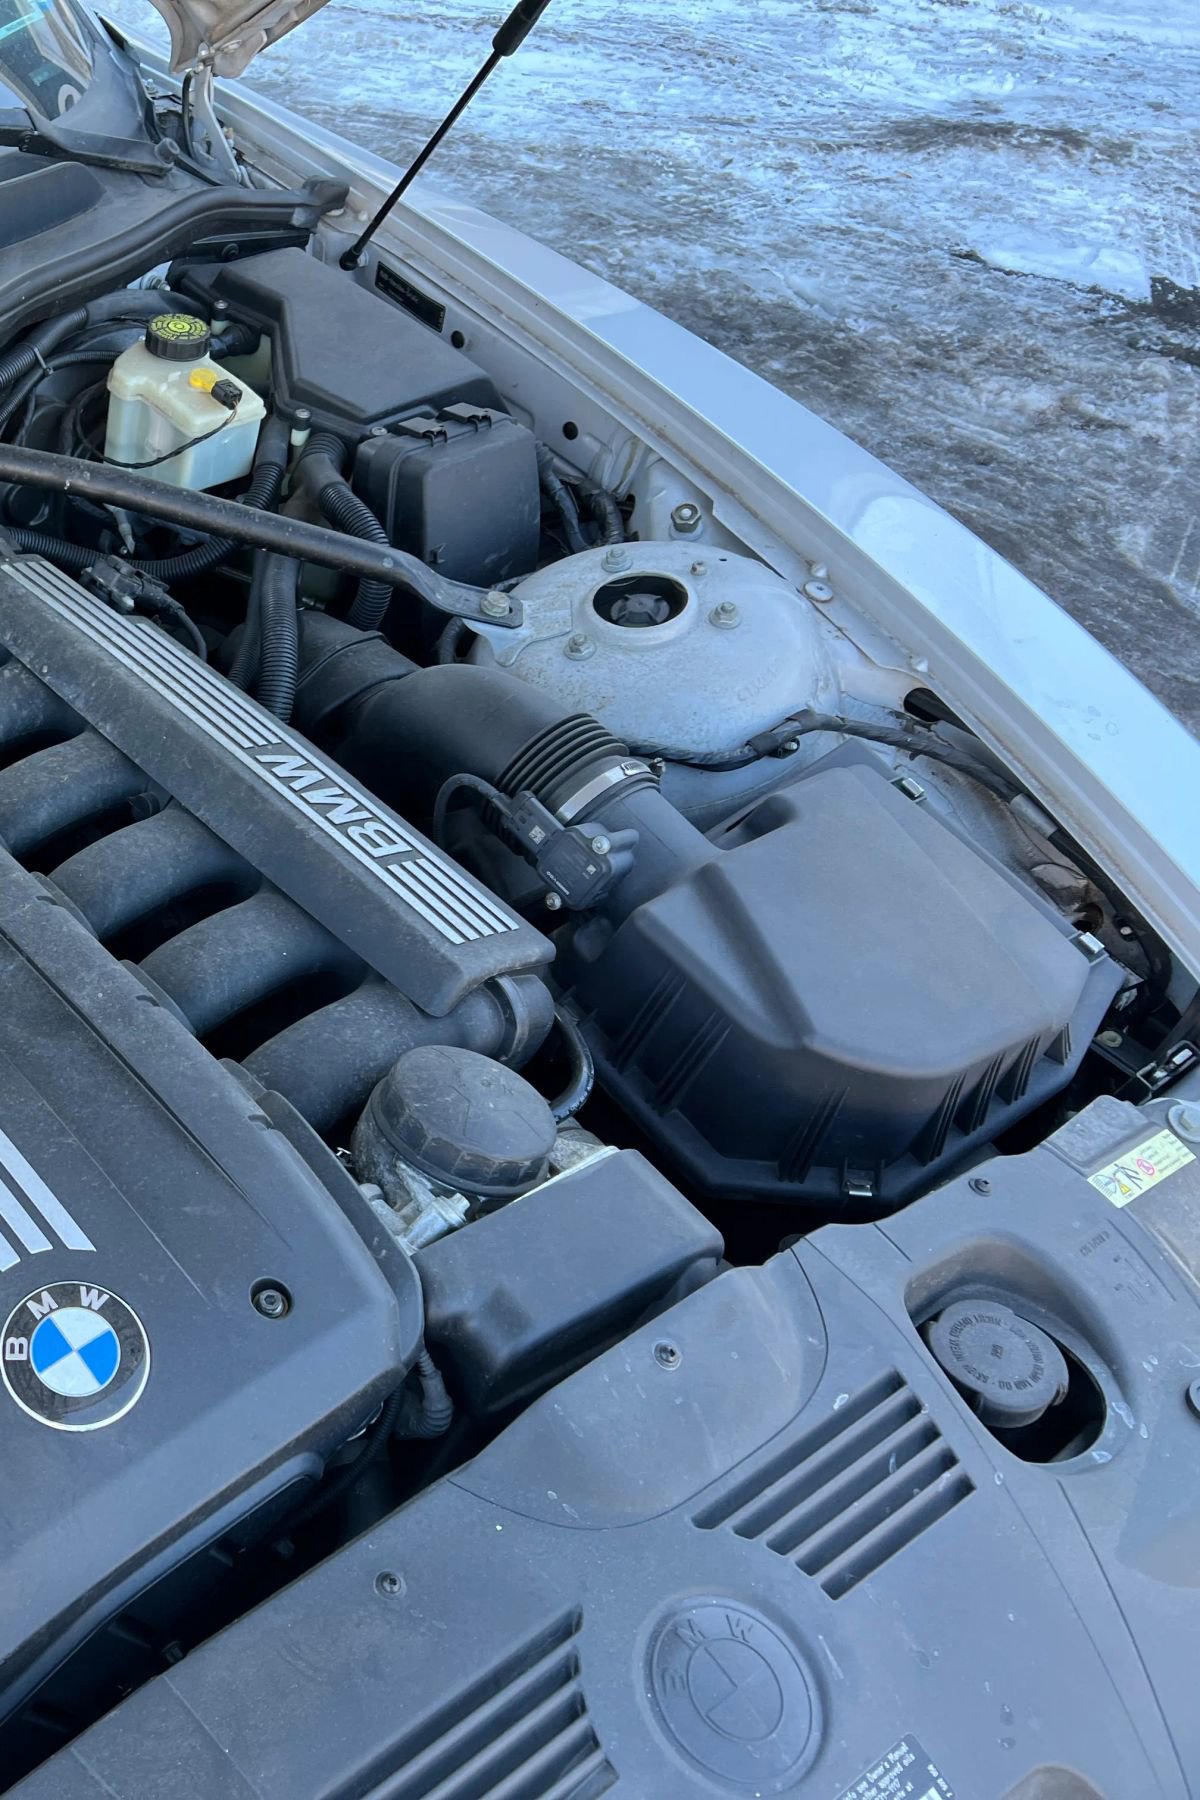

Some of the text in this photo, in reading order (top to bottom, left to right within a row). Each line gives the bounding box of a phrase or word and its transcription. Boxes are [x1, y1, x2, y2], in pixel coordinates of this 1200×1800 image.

[255, 755, 412, 858] BMW
[5, 1286, 110, 1361] BMW
[662, 1614, 755, 1697] BMW
[865, 1761, 890, 1784] Owner's
[887, 1741, 909, 1764] Manual
